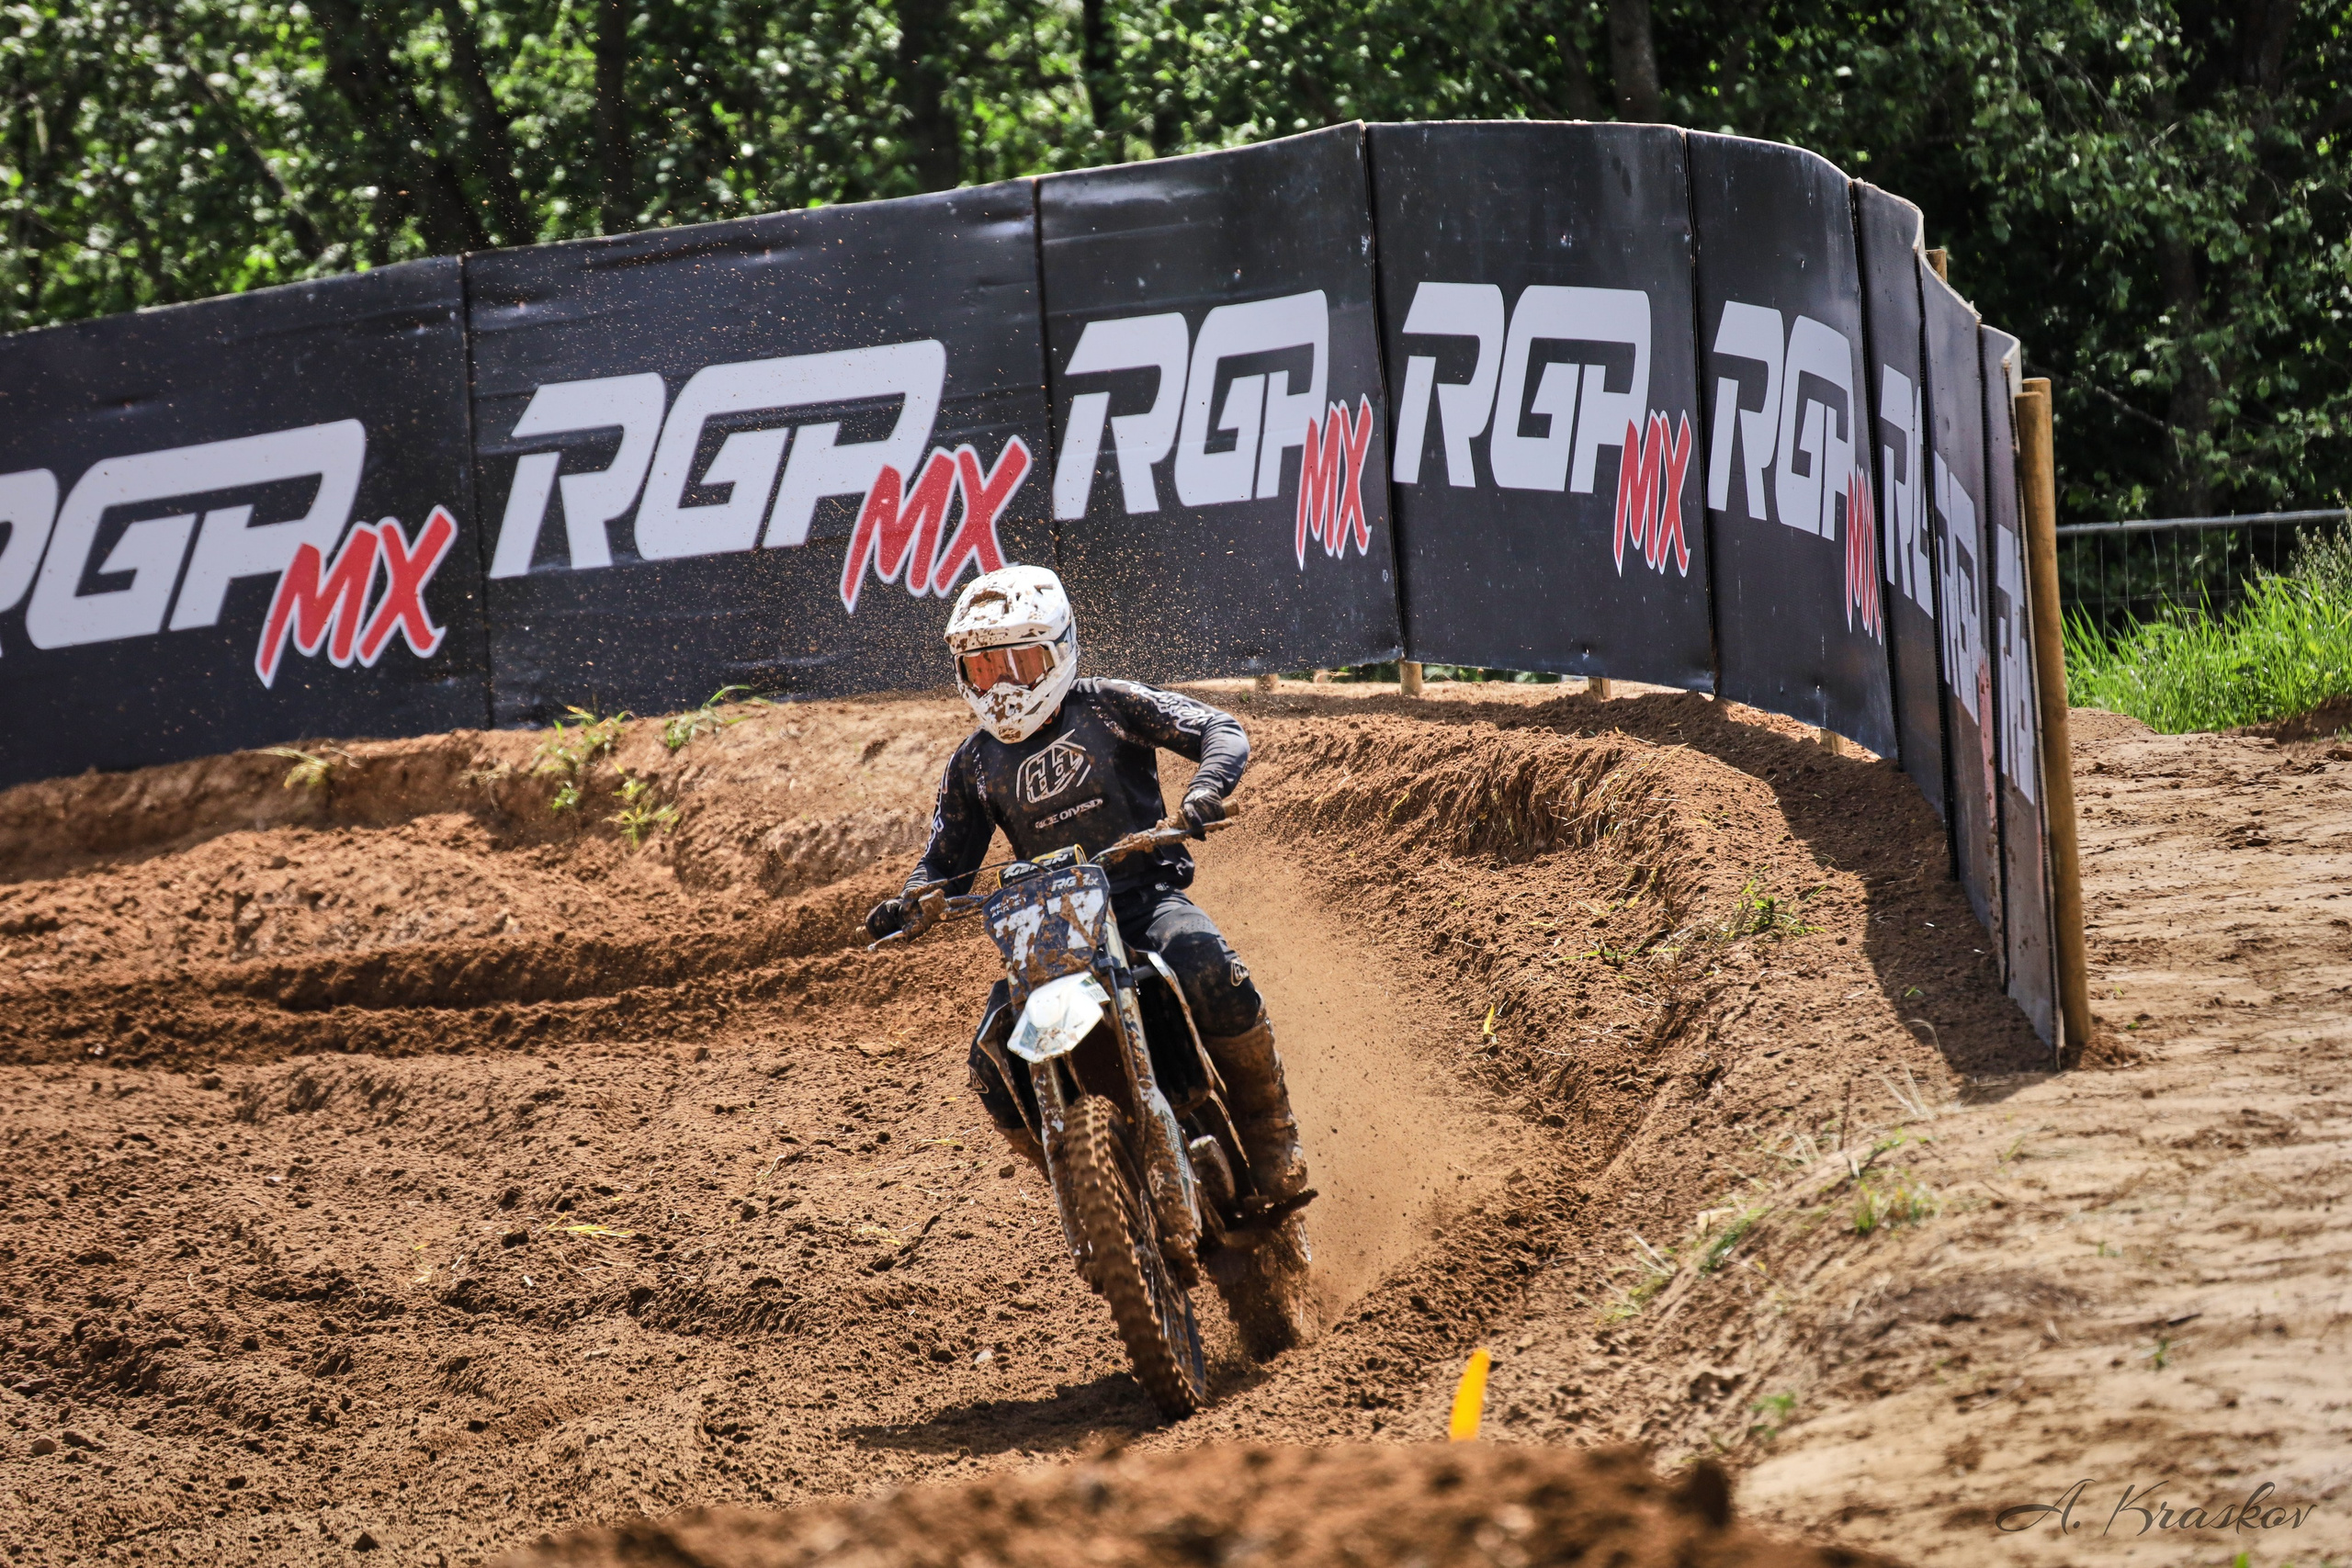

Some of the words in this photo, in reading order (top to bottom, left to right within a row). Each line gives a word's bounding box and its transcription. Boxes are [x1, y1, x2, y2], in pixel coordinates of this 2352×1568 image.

[840, 434, 1033, 614] MX
[1295, 393, 1374, 571] MX
[1613, 409, 1692, 578] MX
[1845, 464, 1883, 646] MX
[254, 504, 458, 689] MX
